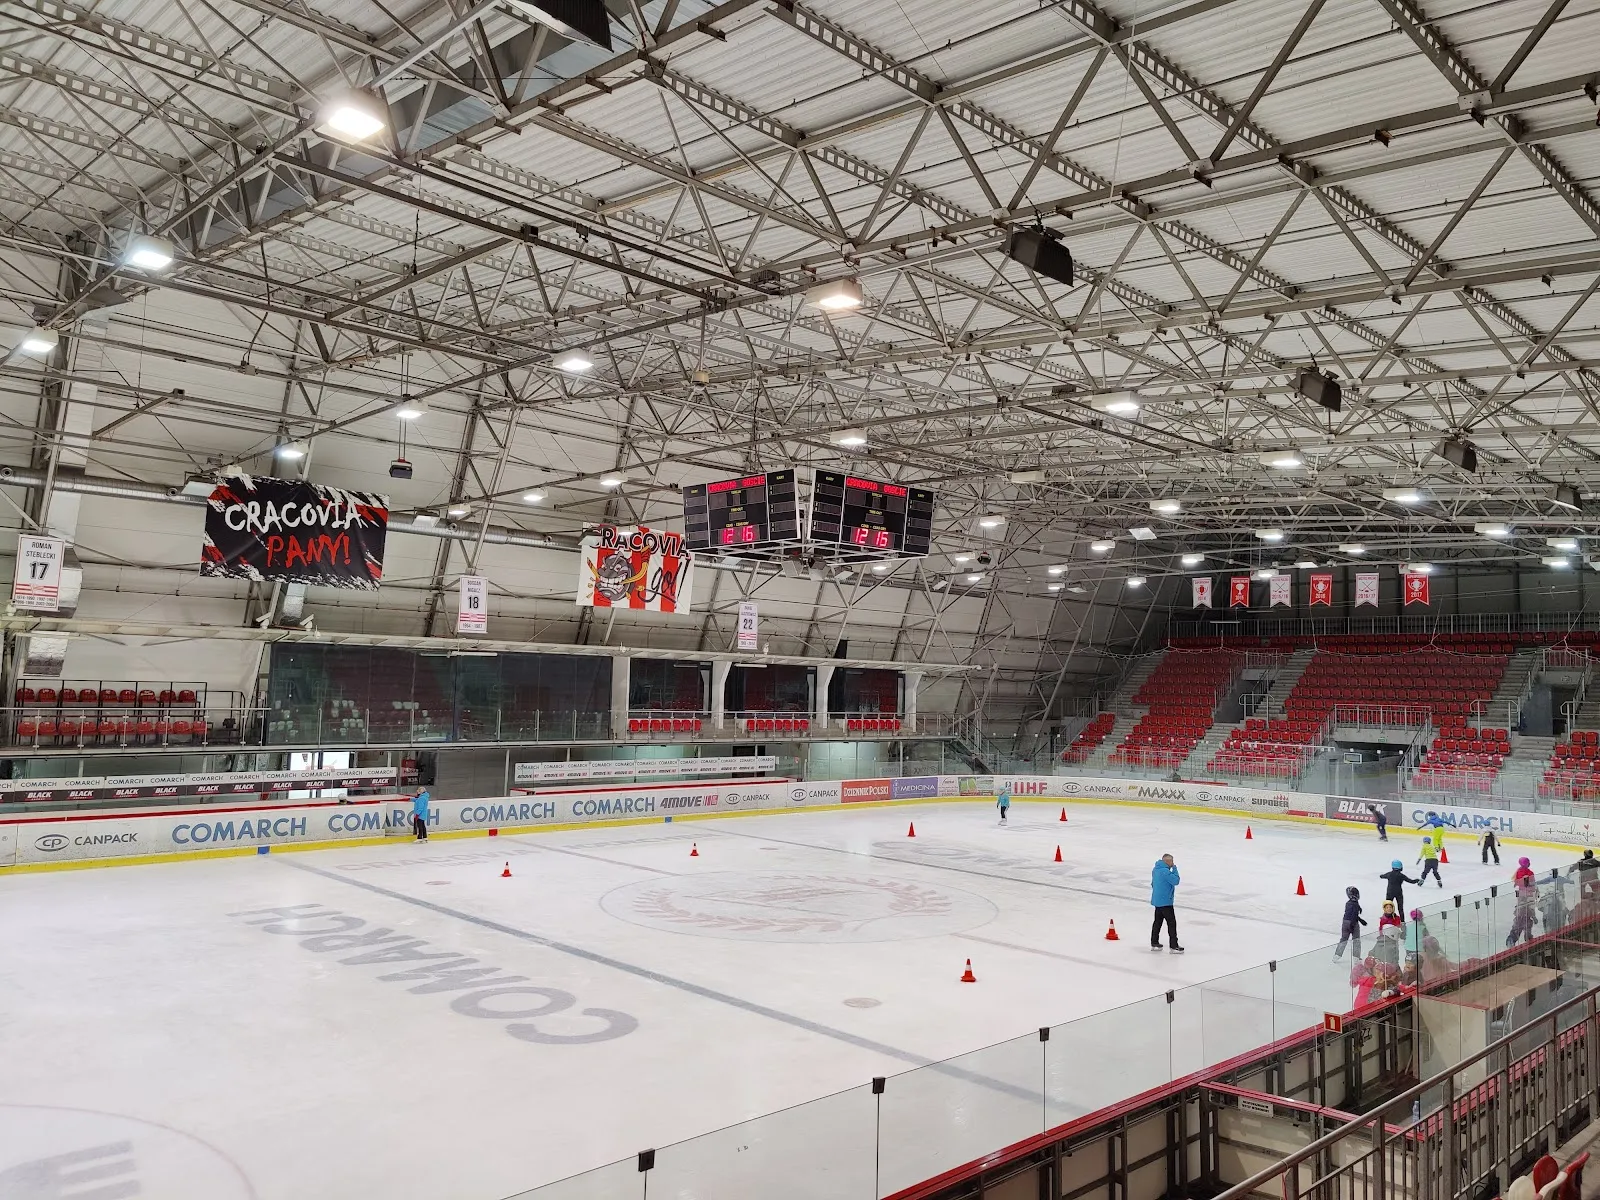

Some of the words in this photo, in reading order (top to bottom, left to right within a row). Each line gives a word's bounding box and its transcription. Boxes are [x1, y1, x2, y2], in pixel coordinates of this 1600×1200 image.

[225, 499, 362, 533] CRACOVIA
[855, 528, 868, 544] 12
[32, 542, 52, 550] ROMAN
[267, 532, 352, 568] PANY!
[26, 551, 56, 559] STEBLECKI
[30, 561, 49, 580] 17
[468, 596, 479, 609] 18
[743, 618, 753, 630] 22
[809, 790, 838, 798] CANPACK
[869, 786, 888, 795] POLSKI
[1014, 782, 1048, 794] IIHF
[1084, 785, 1122, 794] CANPACK
[1138, 786, 1185, 800] MAXXX
[660, 796, 703, 808] 4MOVE
[742, 793, 770, 802] CANPACK
[460, 802, 555, 823] COMARCH
[572, 797, 654, 816] COMARCH
[172, 817, 306, 844] COMARCH
[75, 832, 138, 846] CANPACK
[226, 904, 639, 1045] COMARCH
